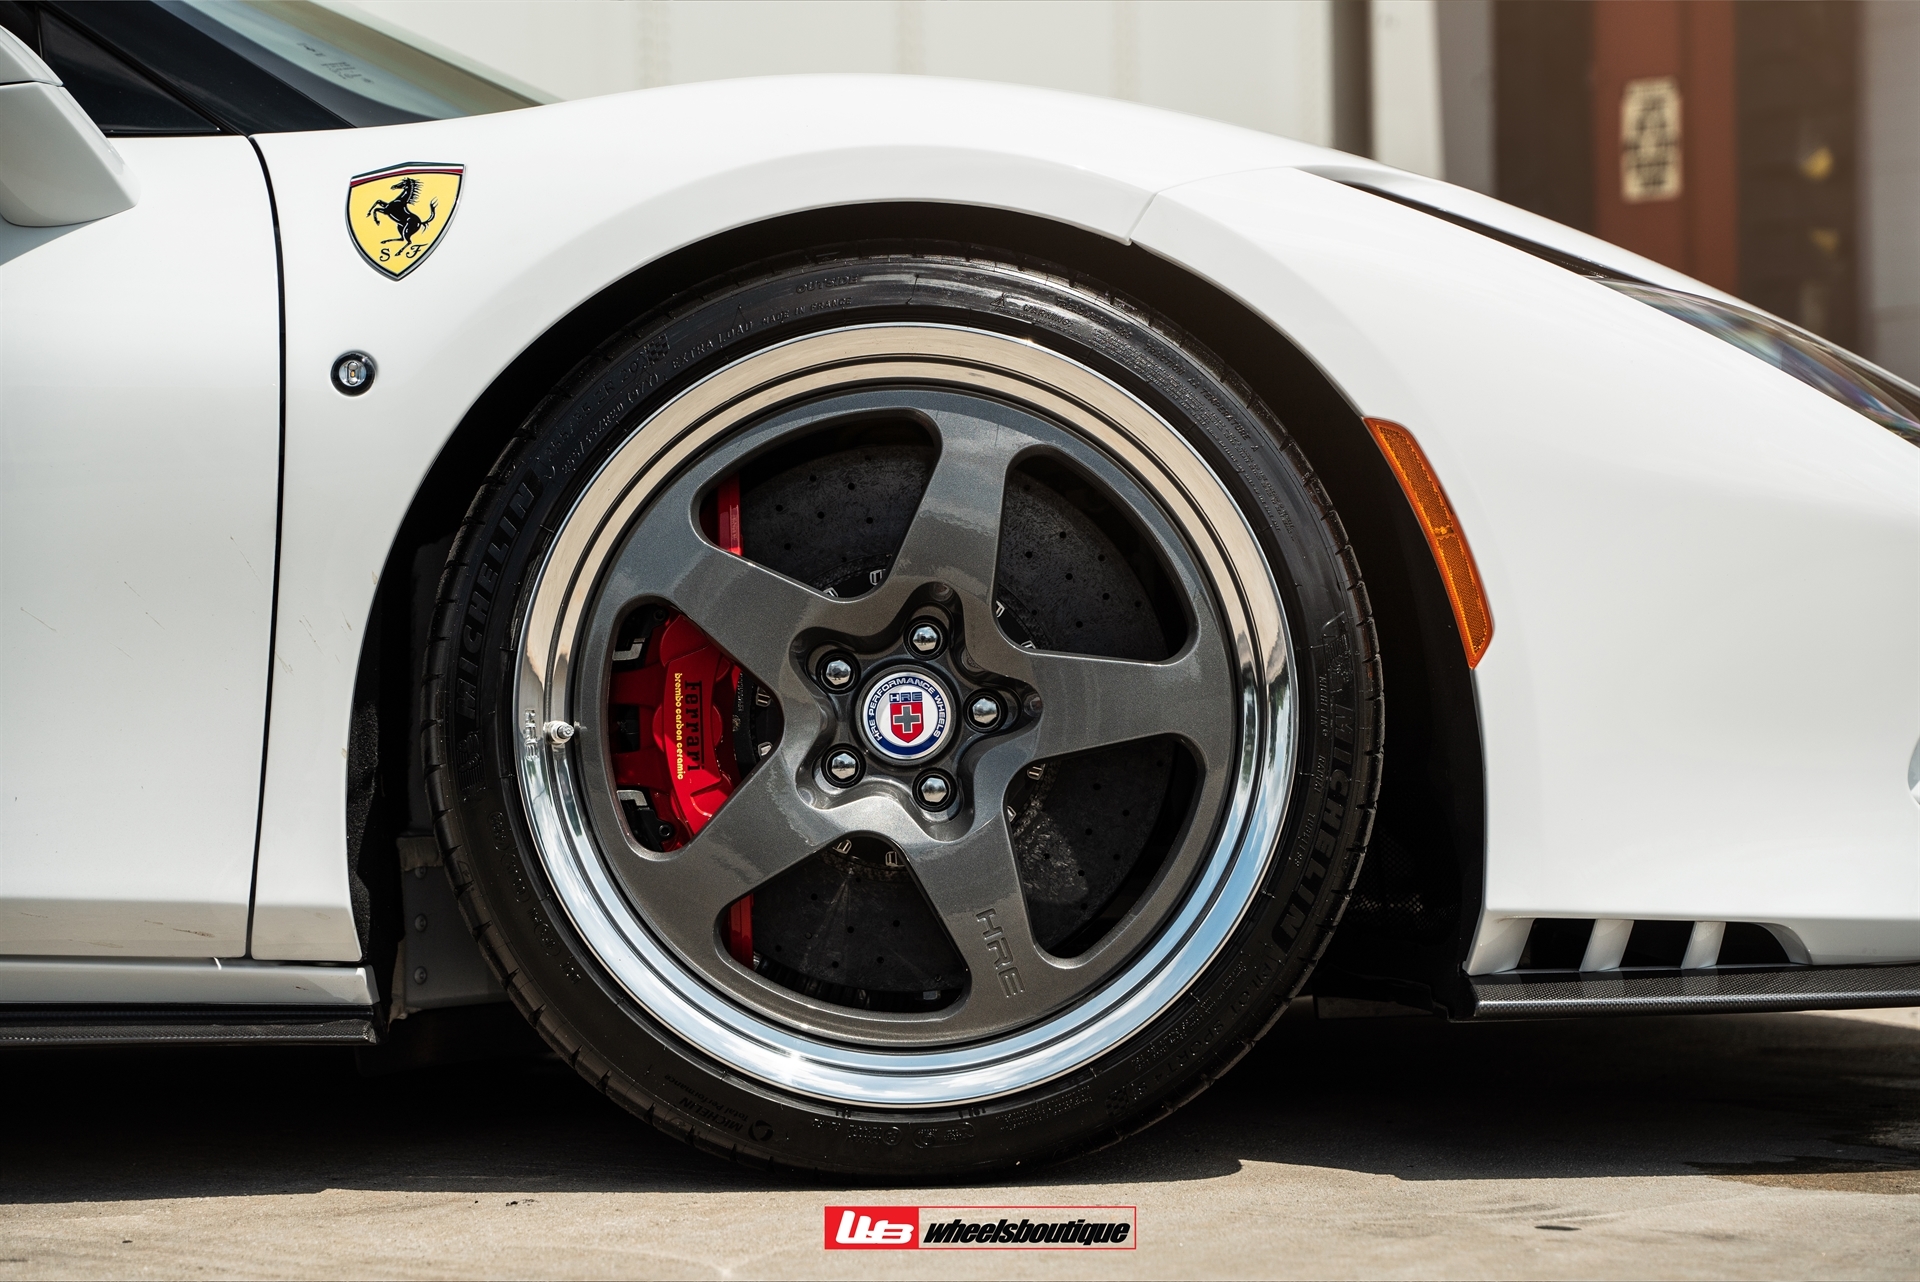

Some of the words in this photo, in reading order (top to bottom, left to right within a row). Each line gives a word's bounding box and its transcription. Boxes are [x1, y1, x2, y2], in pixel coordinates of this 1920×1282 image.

[379, 248, 391, 262] S
[796, 273, 859, 295] OUTSIDE
[762, 308, 789, 327] MADE
[810, 295, 852, 312] FRANCE
[671, 336, 712, 371] EXTRA
[718, 318, 752, 344] LOAD
[1141, 342, 1187, 376] TRACTION
[1198, 388, 1252, 440] TEMPERATURE
[455, 482, 534, 721] MICHELIN
[674, 673, 684, 708] brembo
[868, 677, 936, 716] PERFORMANCE
[890, 693, 922, 702] HRE
[675, 708, 685, 741] carbon
[685, 681, 705, 771] Ferrari
[868, 719, 883, 741] HRE
[933, 695, 946, 738] WHEELS
[676, 742, 686, 780] ceramic
[1280, 703, 1354, 941] MICHELIN
[976, 907, 1025, 998] HRE
[1161, 1017, 1224, 1078] SPORT
[662, 1071, 727, 1111] Performance
[676, 1095, 745, 1133] MICHELIN
[724, 1106, 749, 1122] Total
